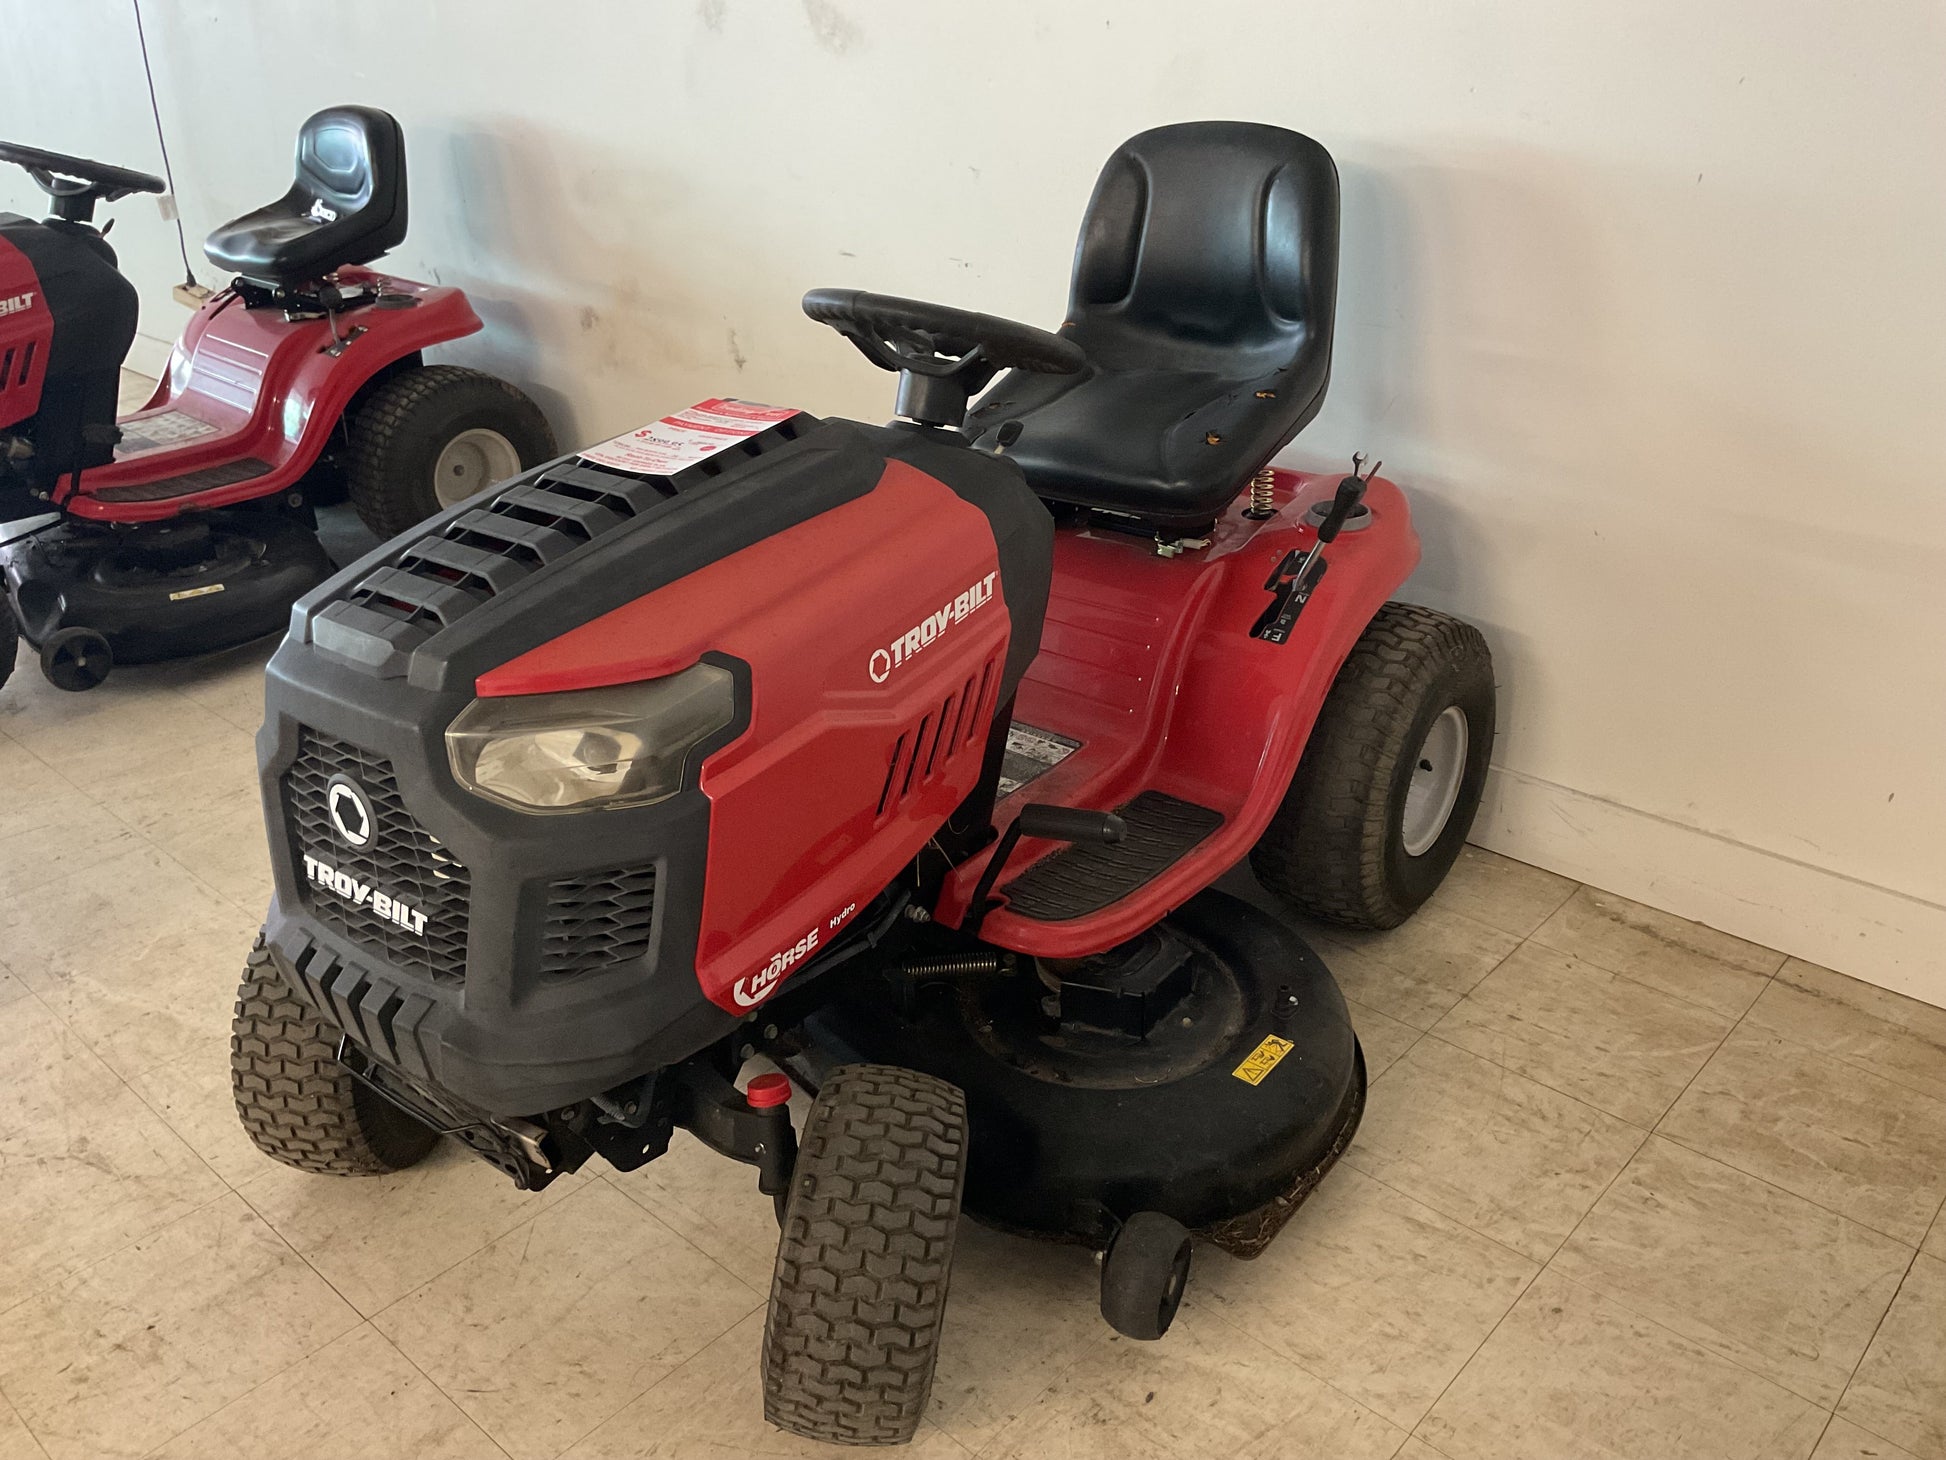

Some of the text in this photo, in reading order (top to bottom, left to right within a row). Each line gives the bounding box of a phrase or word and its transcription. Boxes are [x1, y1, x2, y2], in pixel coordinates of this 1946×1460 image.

[891, 571, 996, 668] TROY-BILT
[303, 854, 428, 936] TROY-BILT
[829, 902, 856, 929] Hydro
